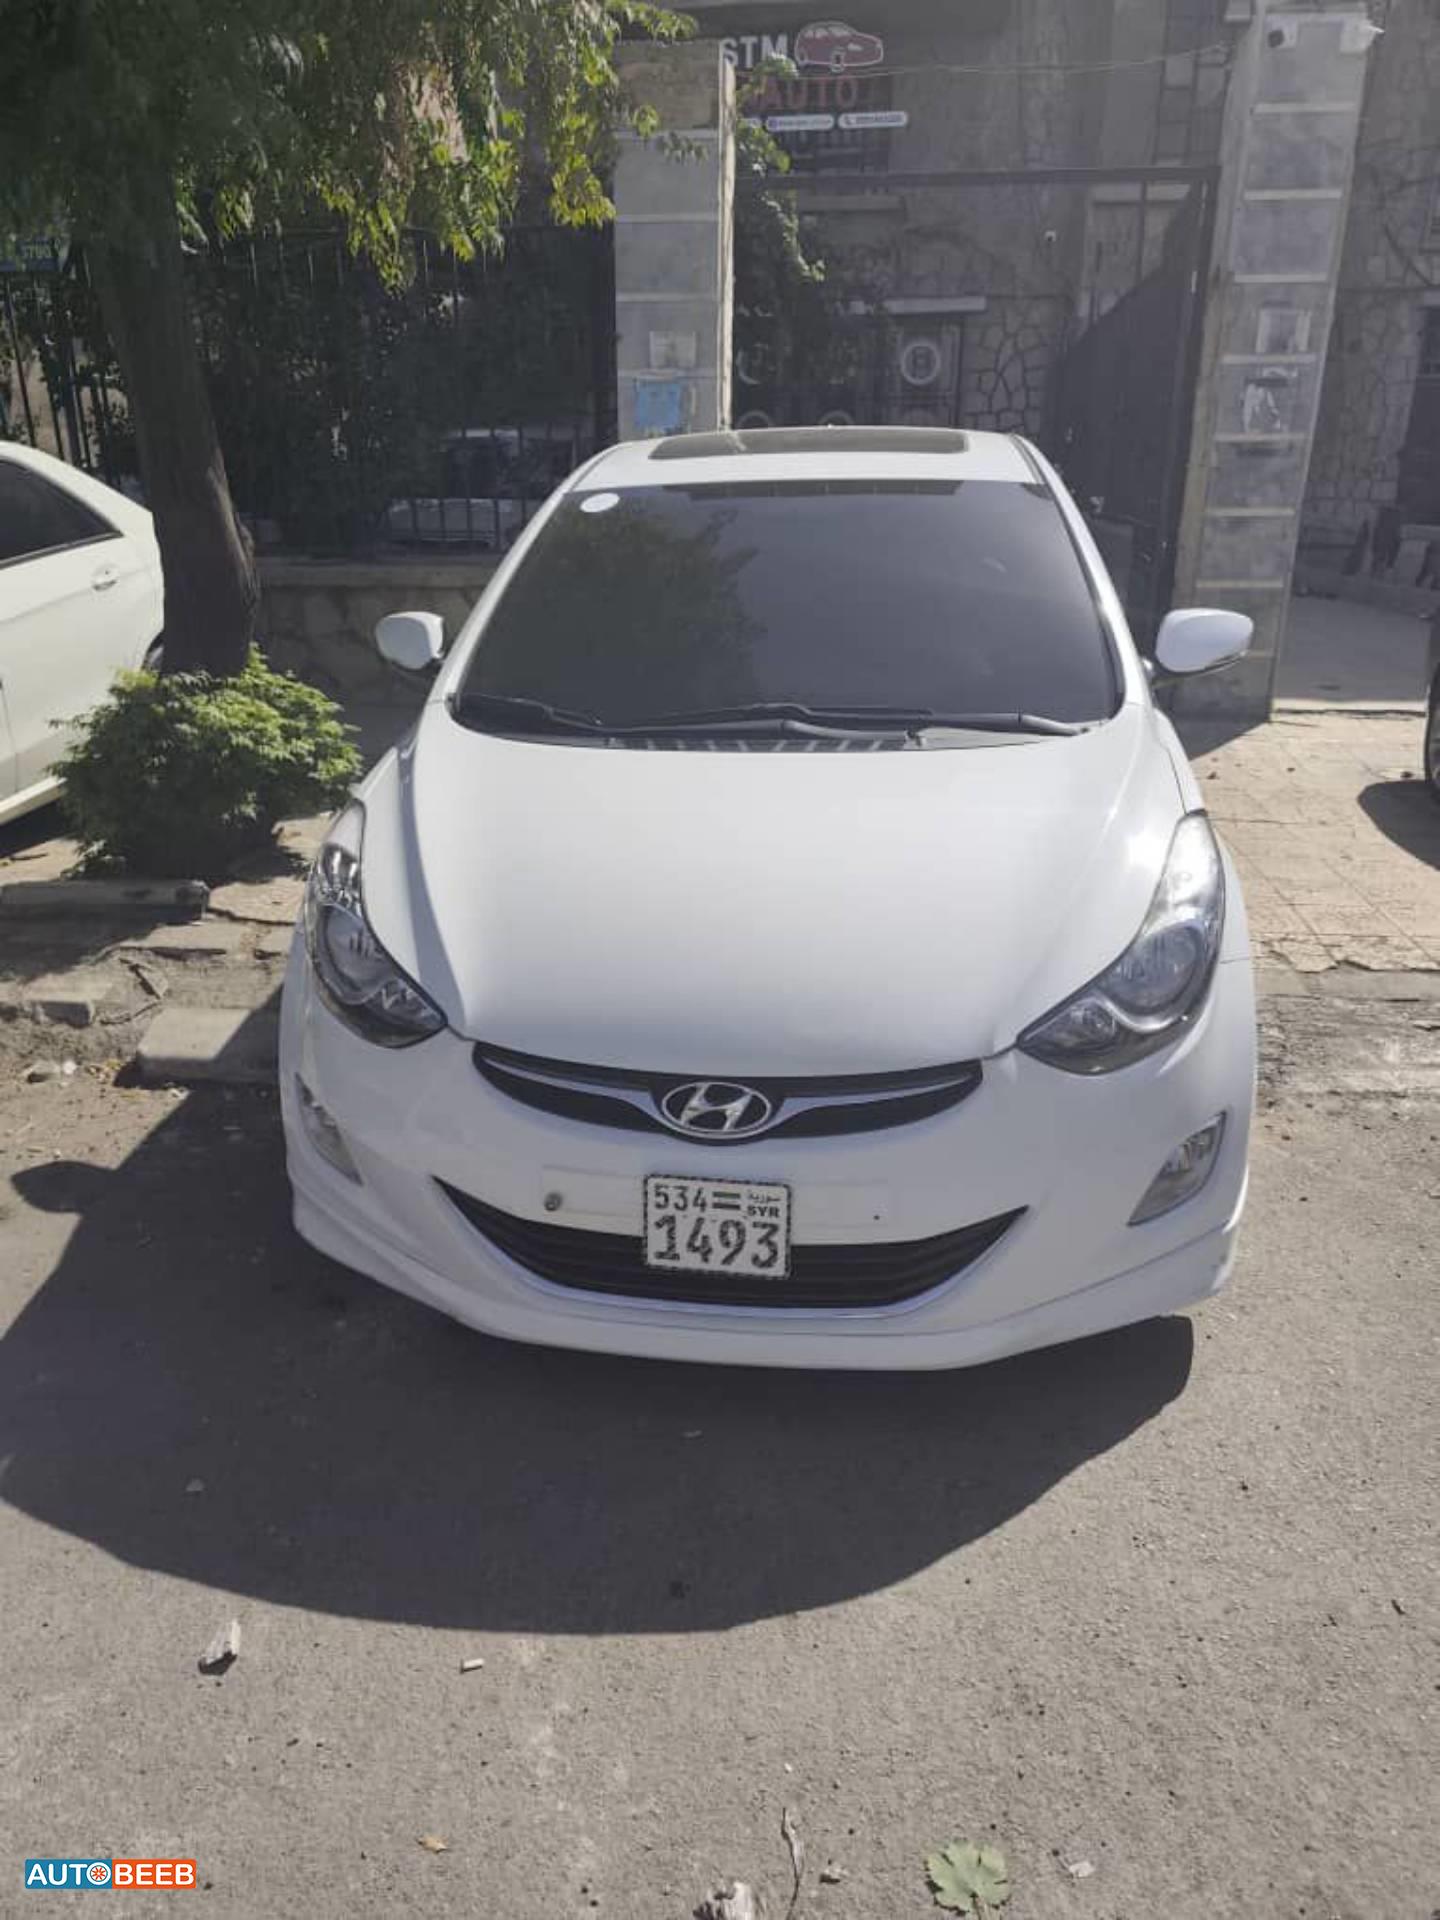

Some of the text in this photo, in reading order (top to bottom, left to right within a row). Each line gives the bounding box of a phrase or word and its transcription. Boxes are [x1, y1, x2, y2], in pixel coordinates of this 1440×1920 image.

[719, 34, 788, 68] STM
[654, 1184, 707, 1212] 534
[747, 1205, 780, 1218] SYR
[654, 1215, 780, 1269] 1493
